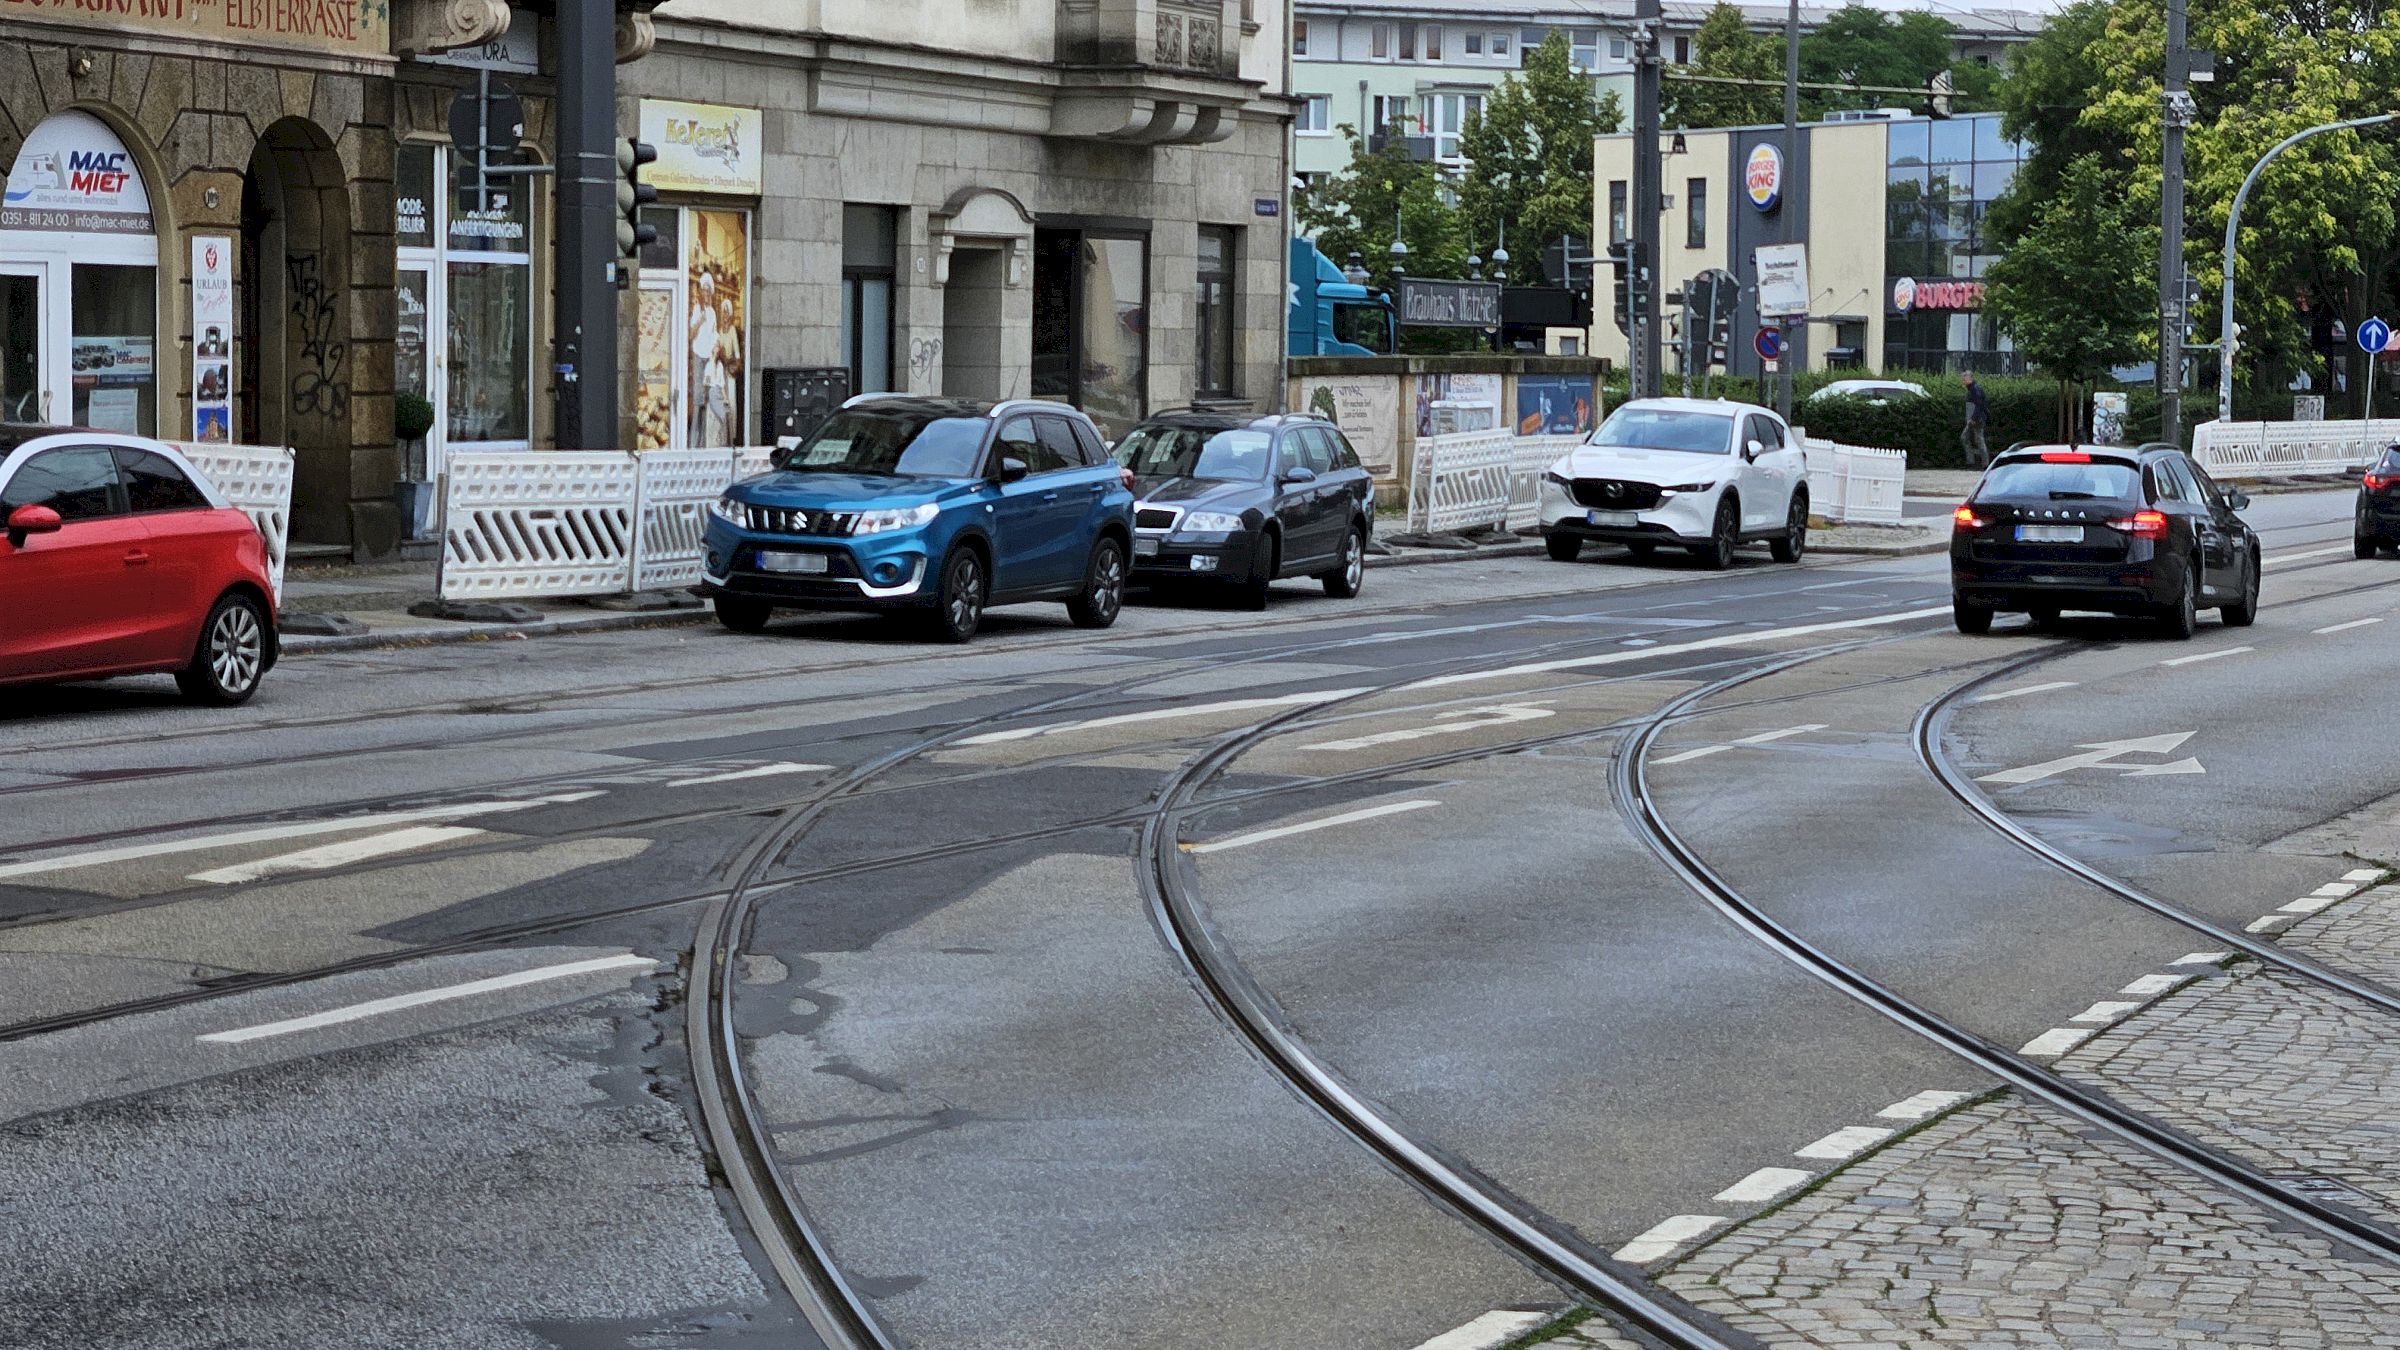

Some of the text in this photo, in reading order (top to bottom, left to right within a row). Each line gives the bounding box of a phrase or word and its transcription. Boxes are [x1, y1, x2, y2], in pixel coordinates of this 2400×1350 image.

[226, 0, 358, 41] ELBTERRASSE
[69, 150, 127, 172] MAC
[1750, 159, 1776, 171] BURGER
[70, 170, 131, 195] MIET
[1749, 171, 1776, 189] KING
[1, 211, 22, 225] 0351
[42, 213, 55, 225] 24
[56, 213, 69, 227] 00
[196, 278, 228, 290] URLAUB
[1406, 285, 1492, 323] Brauhaus Watzke
